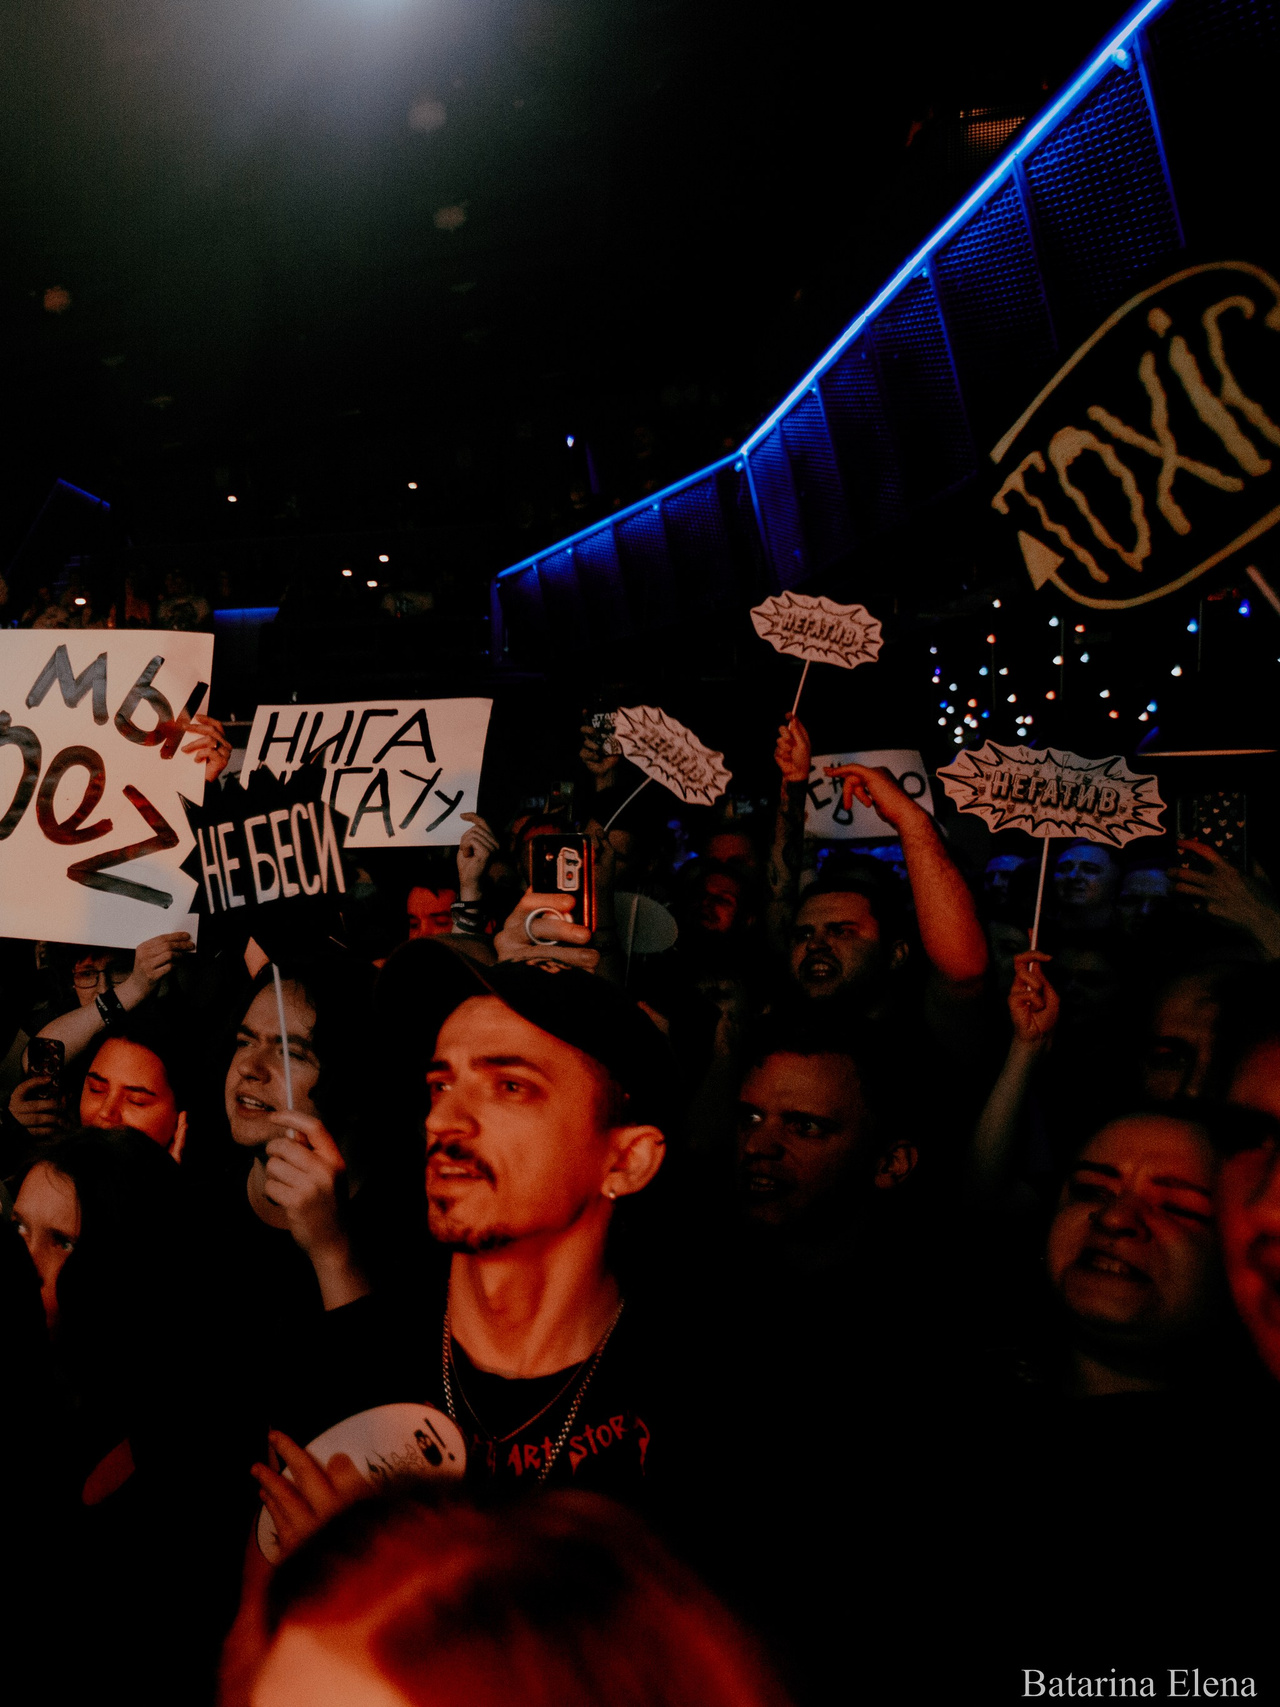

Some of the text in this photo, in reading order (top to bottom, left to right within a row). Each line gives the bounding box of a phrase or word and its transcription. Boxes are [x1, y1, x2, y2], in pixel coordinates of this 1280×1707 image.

[780, 612, 857, 647] НЕГАТИВ
[990, 770, 1123, 816] НЕГАТИВ
[198, 802, 346, 914] НЕ БЕСИ
